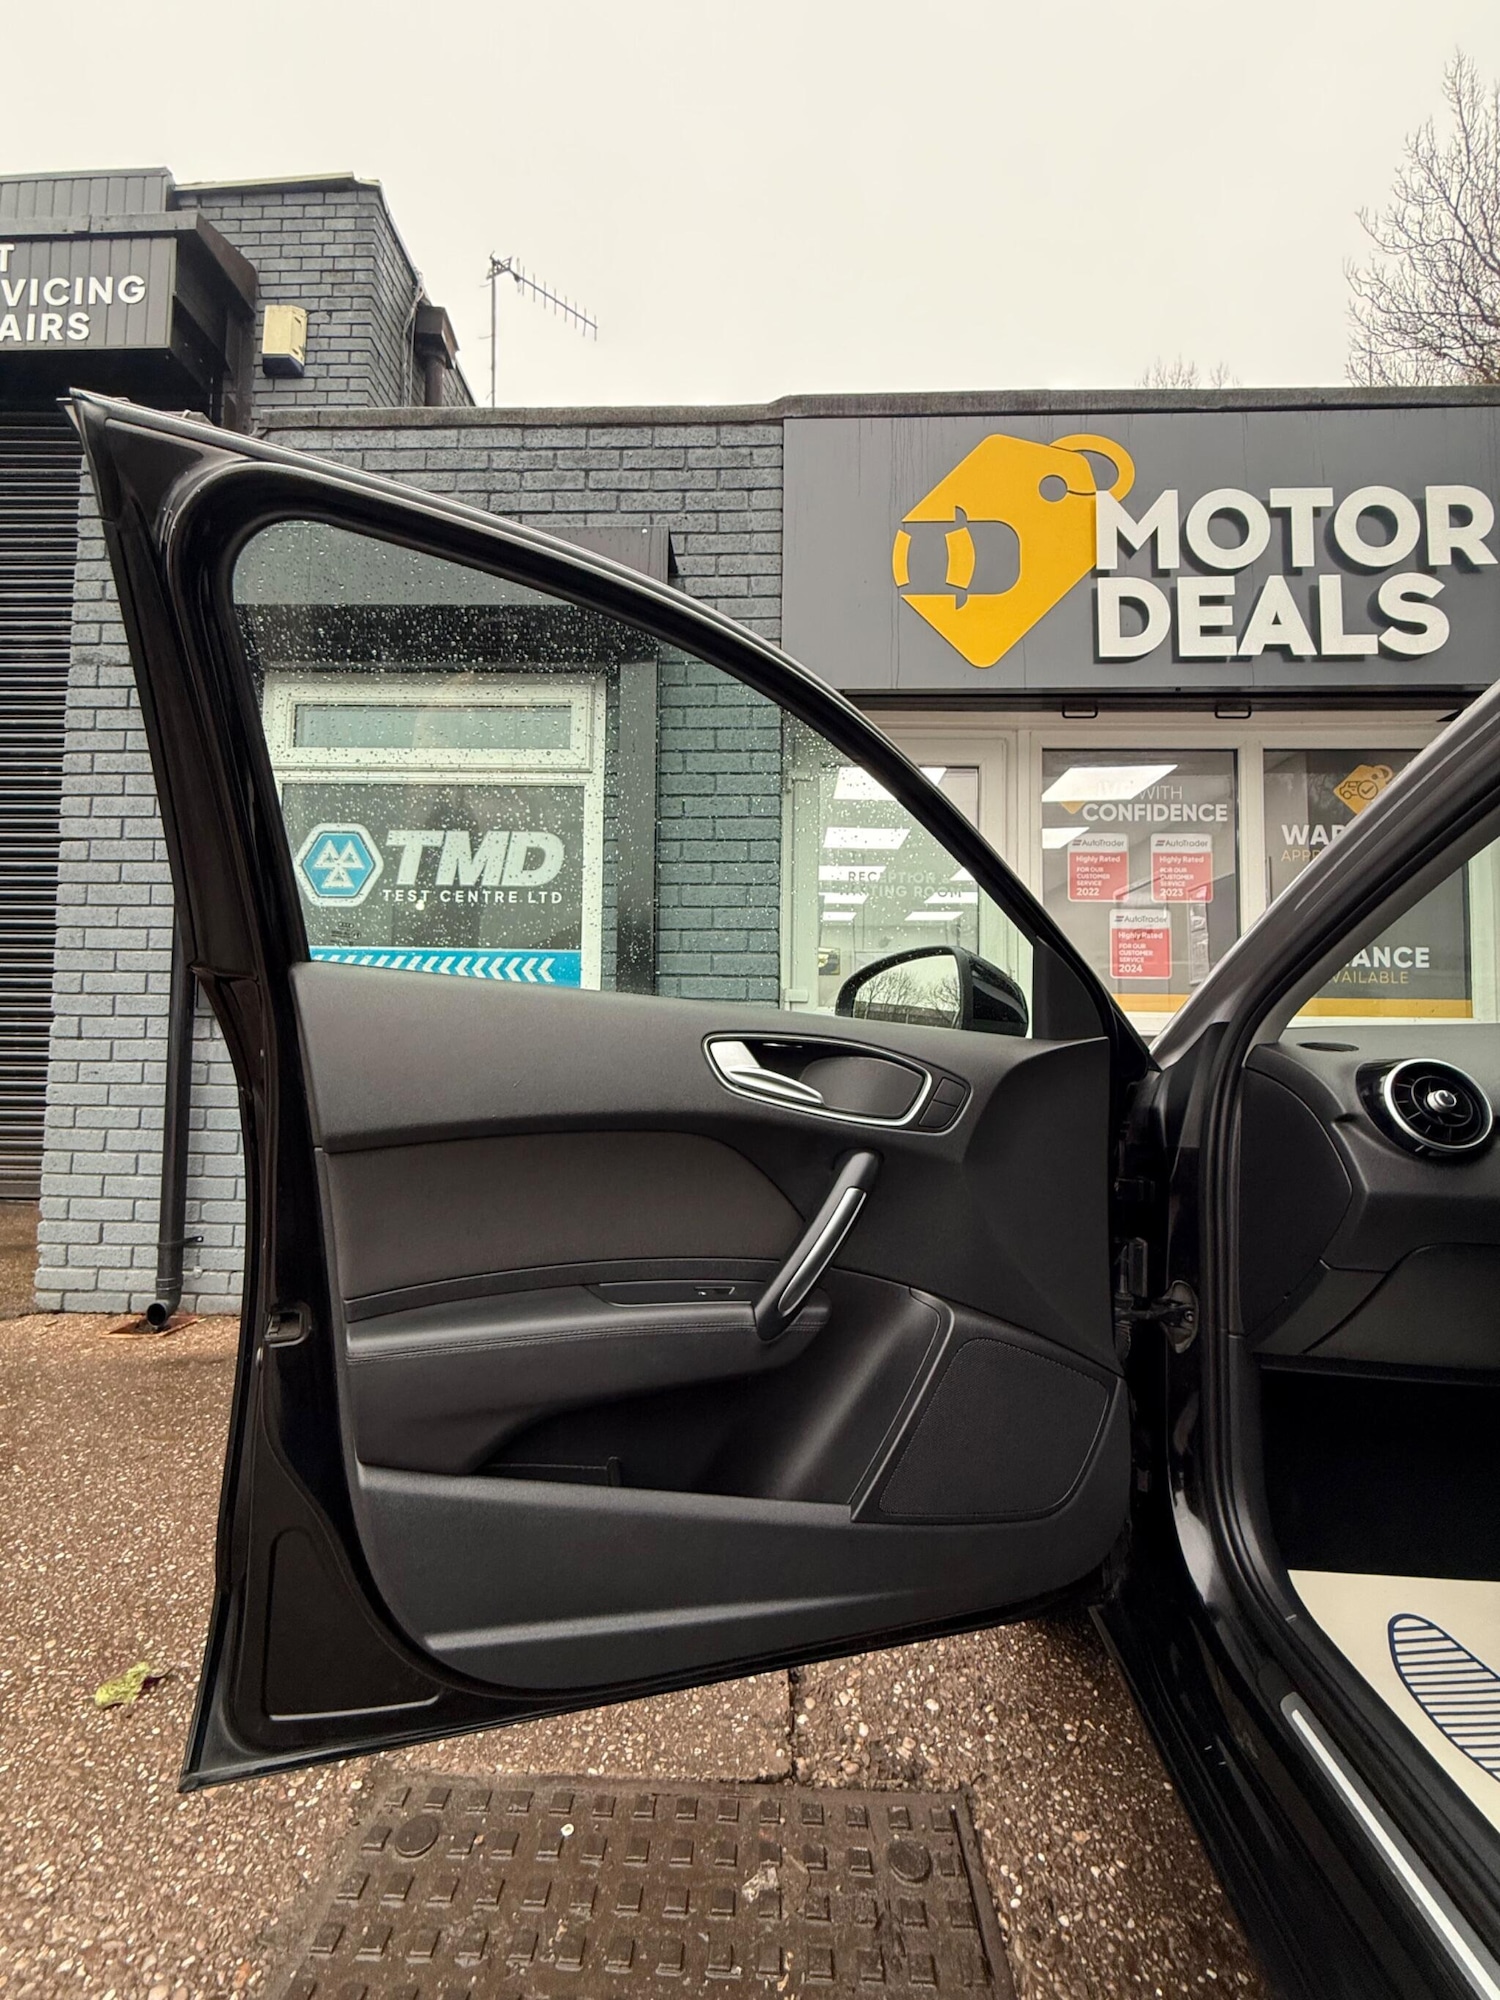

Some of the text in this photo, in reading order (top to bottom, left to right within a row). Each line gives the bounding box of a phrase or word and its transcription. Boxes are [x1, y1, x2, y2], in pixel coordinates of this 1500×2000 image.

[0, 243, 15, 272] T
[0, 275, 147, 307] VICING
[0, 312, 90, 341] AIRS
[1095, 485, 1498, 570] MOTOR
[1097, 573, 1451, 658] DEALS
[1139, 785, 1182, 800] WITH
[1082, 803, 1228, 822] CONFIDENCE
[386, 830, 565, 887] TMD
[382, 889, 562, 904] TEST CENTRE LTD
[1076, 887, 1100, 896] 2022
[1160, 887, 1184, 897] 2023
[1346, 946, 1430, 968] ANCE
[1118, 963, 1143, 973] 2024
[1330, 971, 1409, 985] VAILABLE
